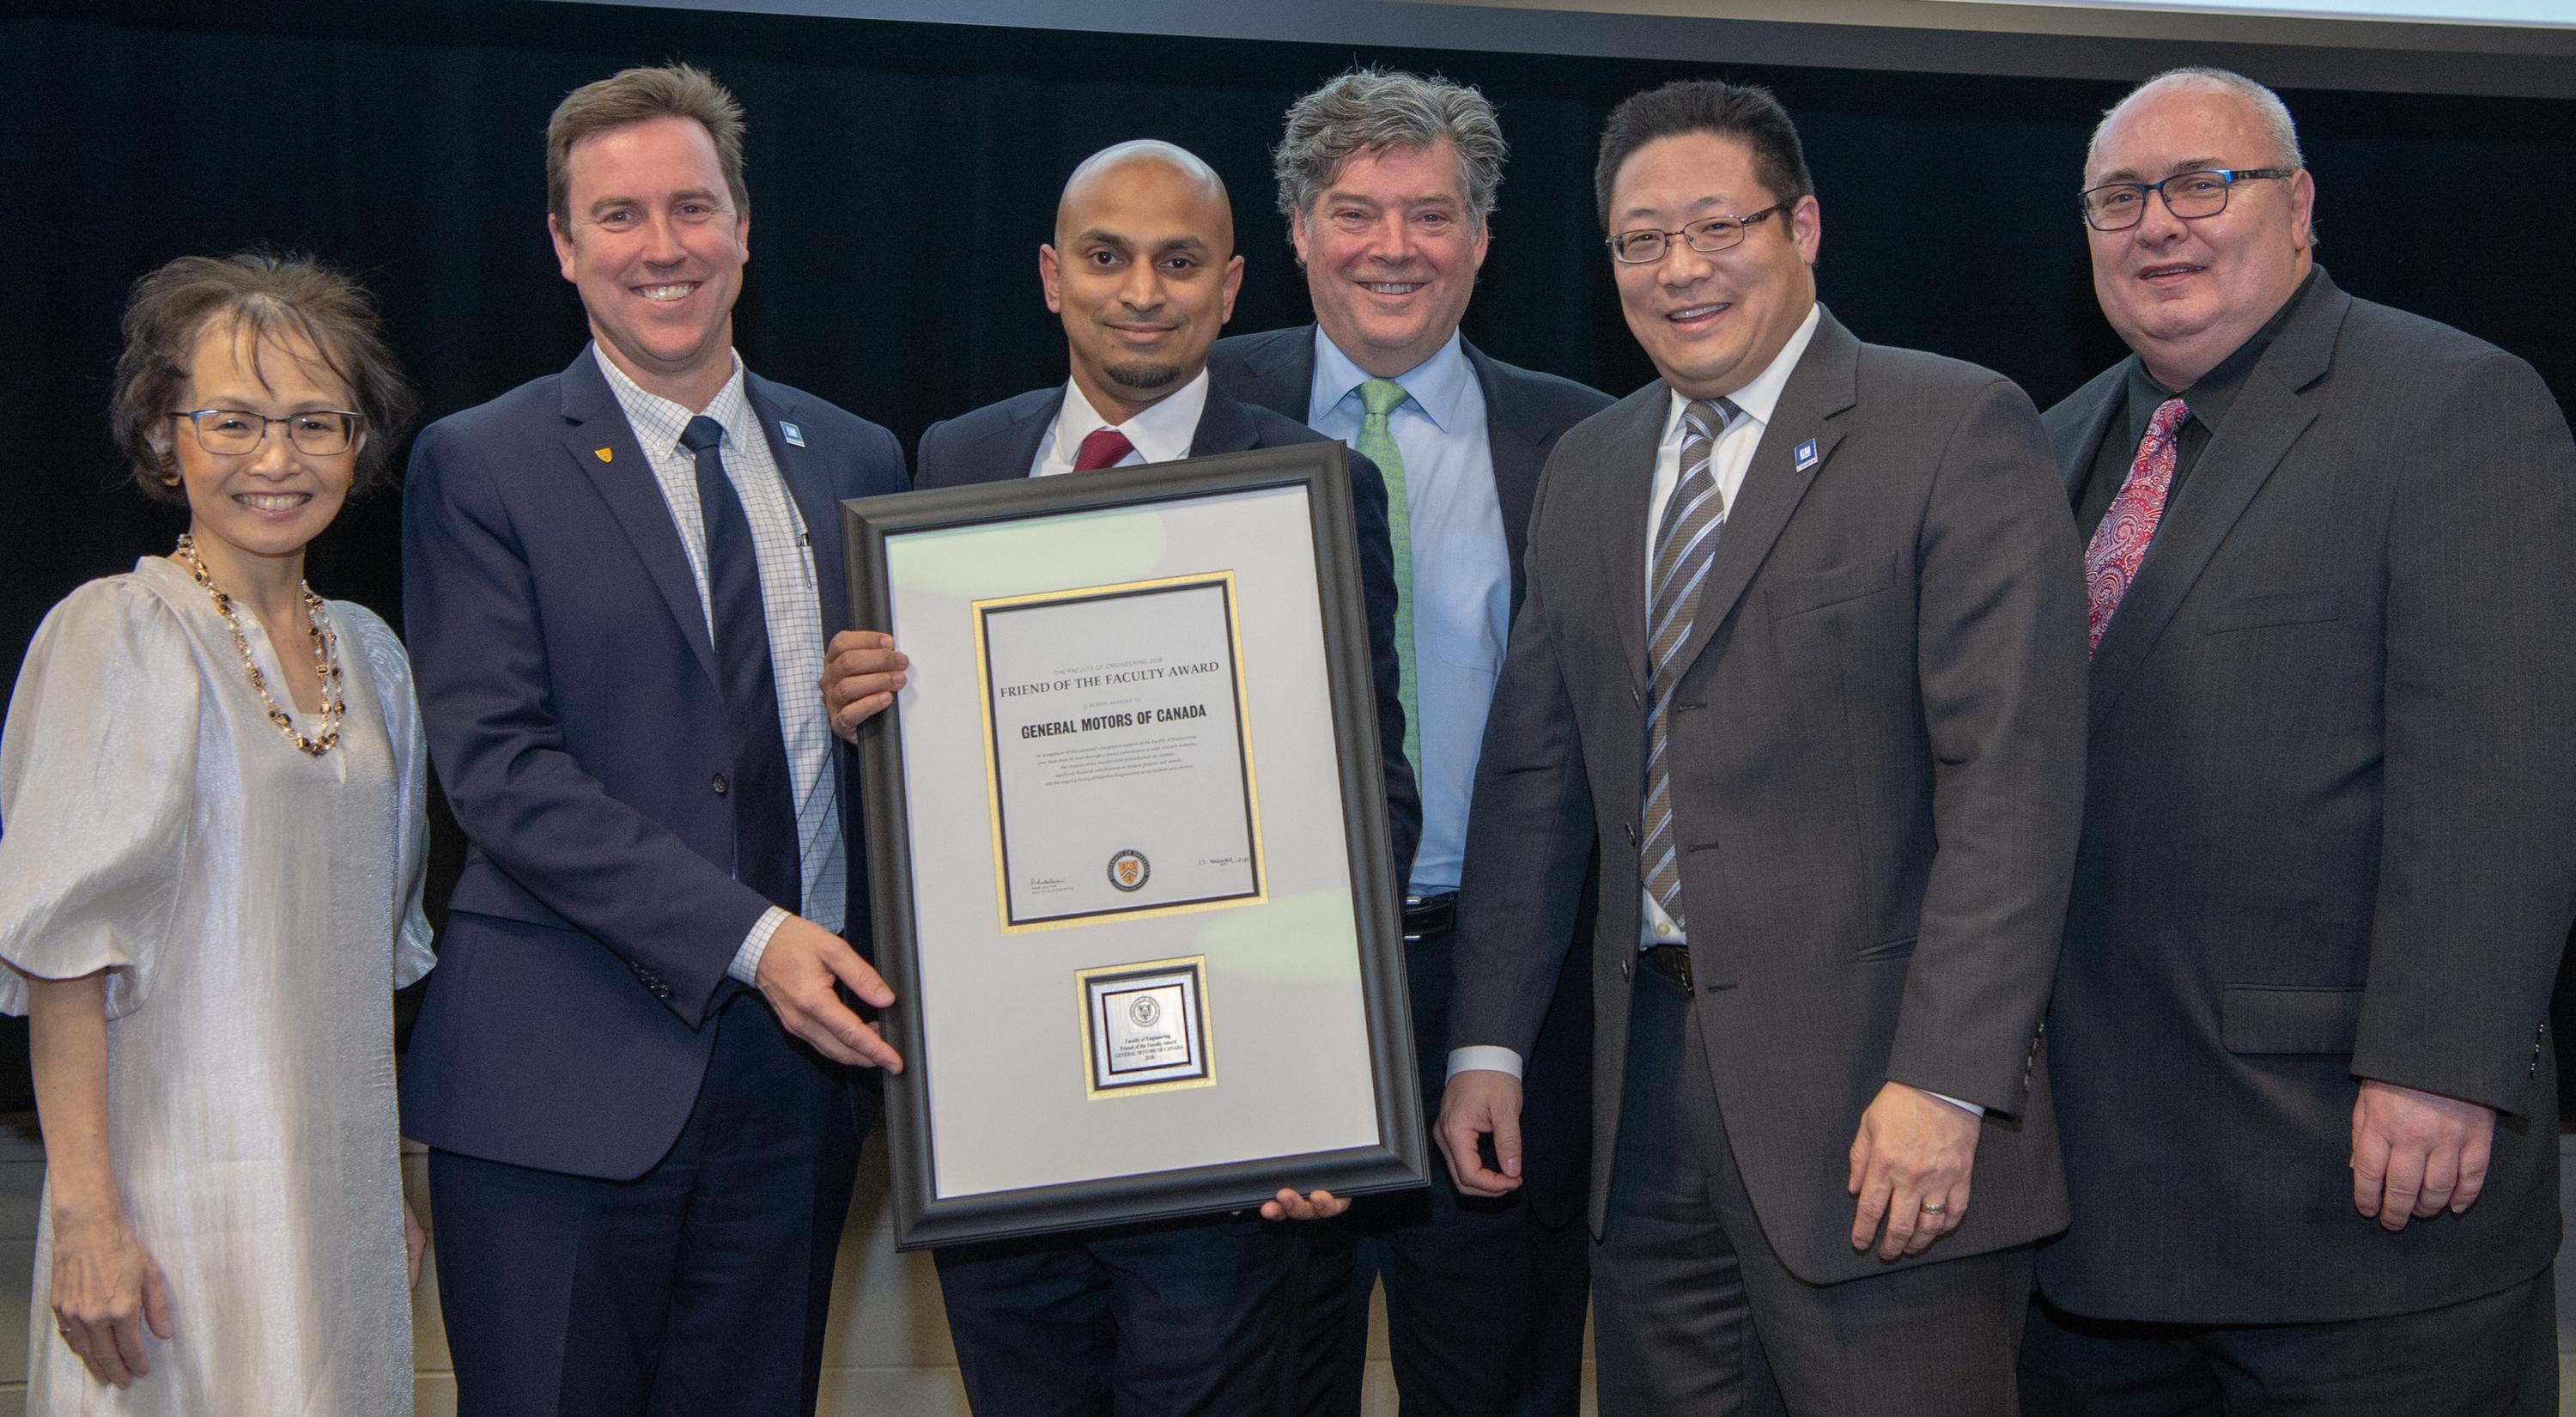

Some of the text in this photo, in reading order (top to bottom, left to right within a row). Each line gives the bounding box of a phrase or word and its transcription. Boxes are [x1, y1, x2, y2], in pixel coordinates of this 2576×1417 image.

[999, 660, 1219, 698] FRIEND OF THE FACULTY AWARD
[1105, 660, 1148, 669] ENGINEERING
[1021, 704, 1206, 739] GENERAL MOTORS OF CANADA
